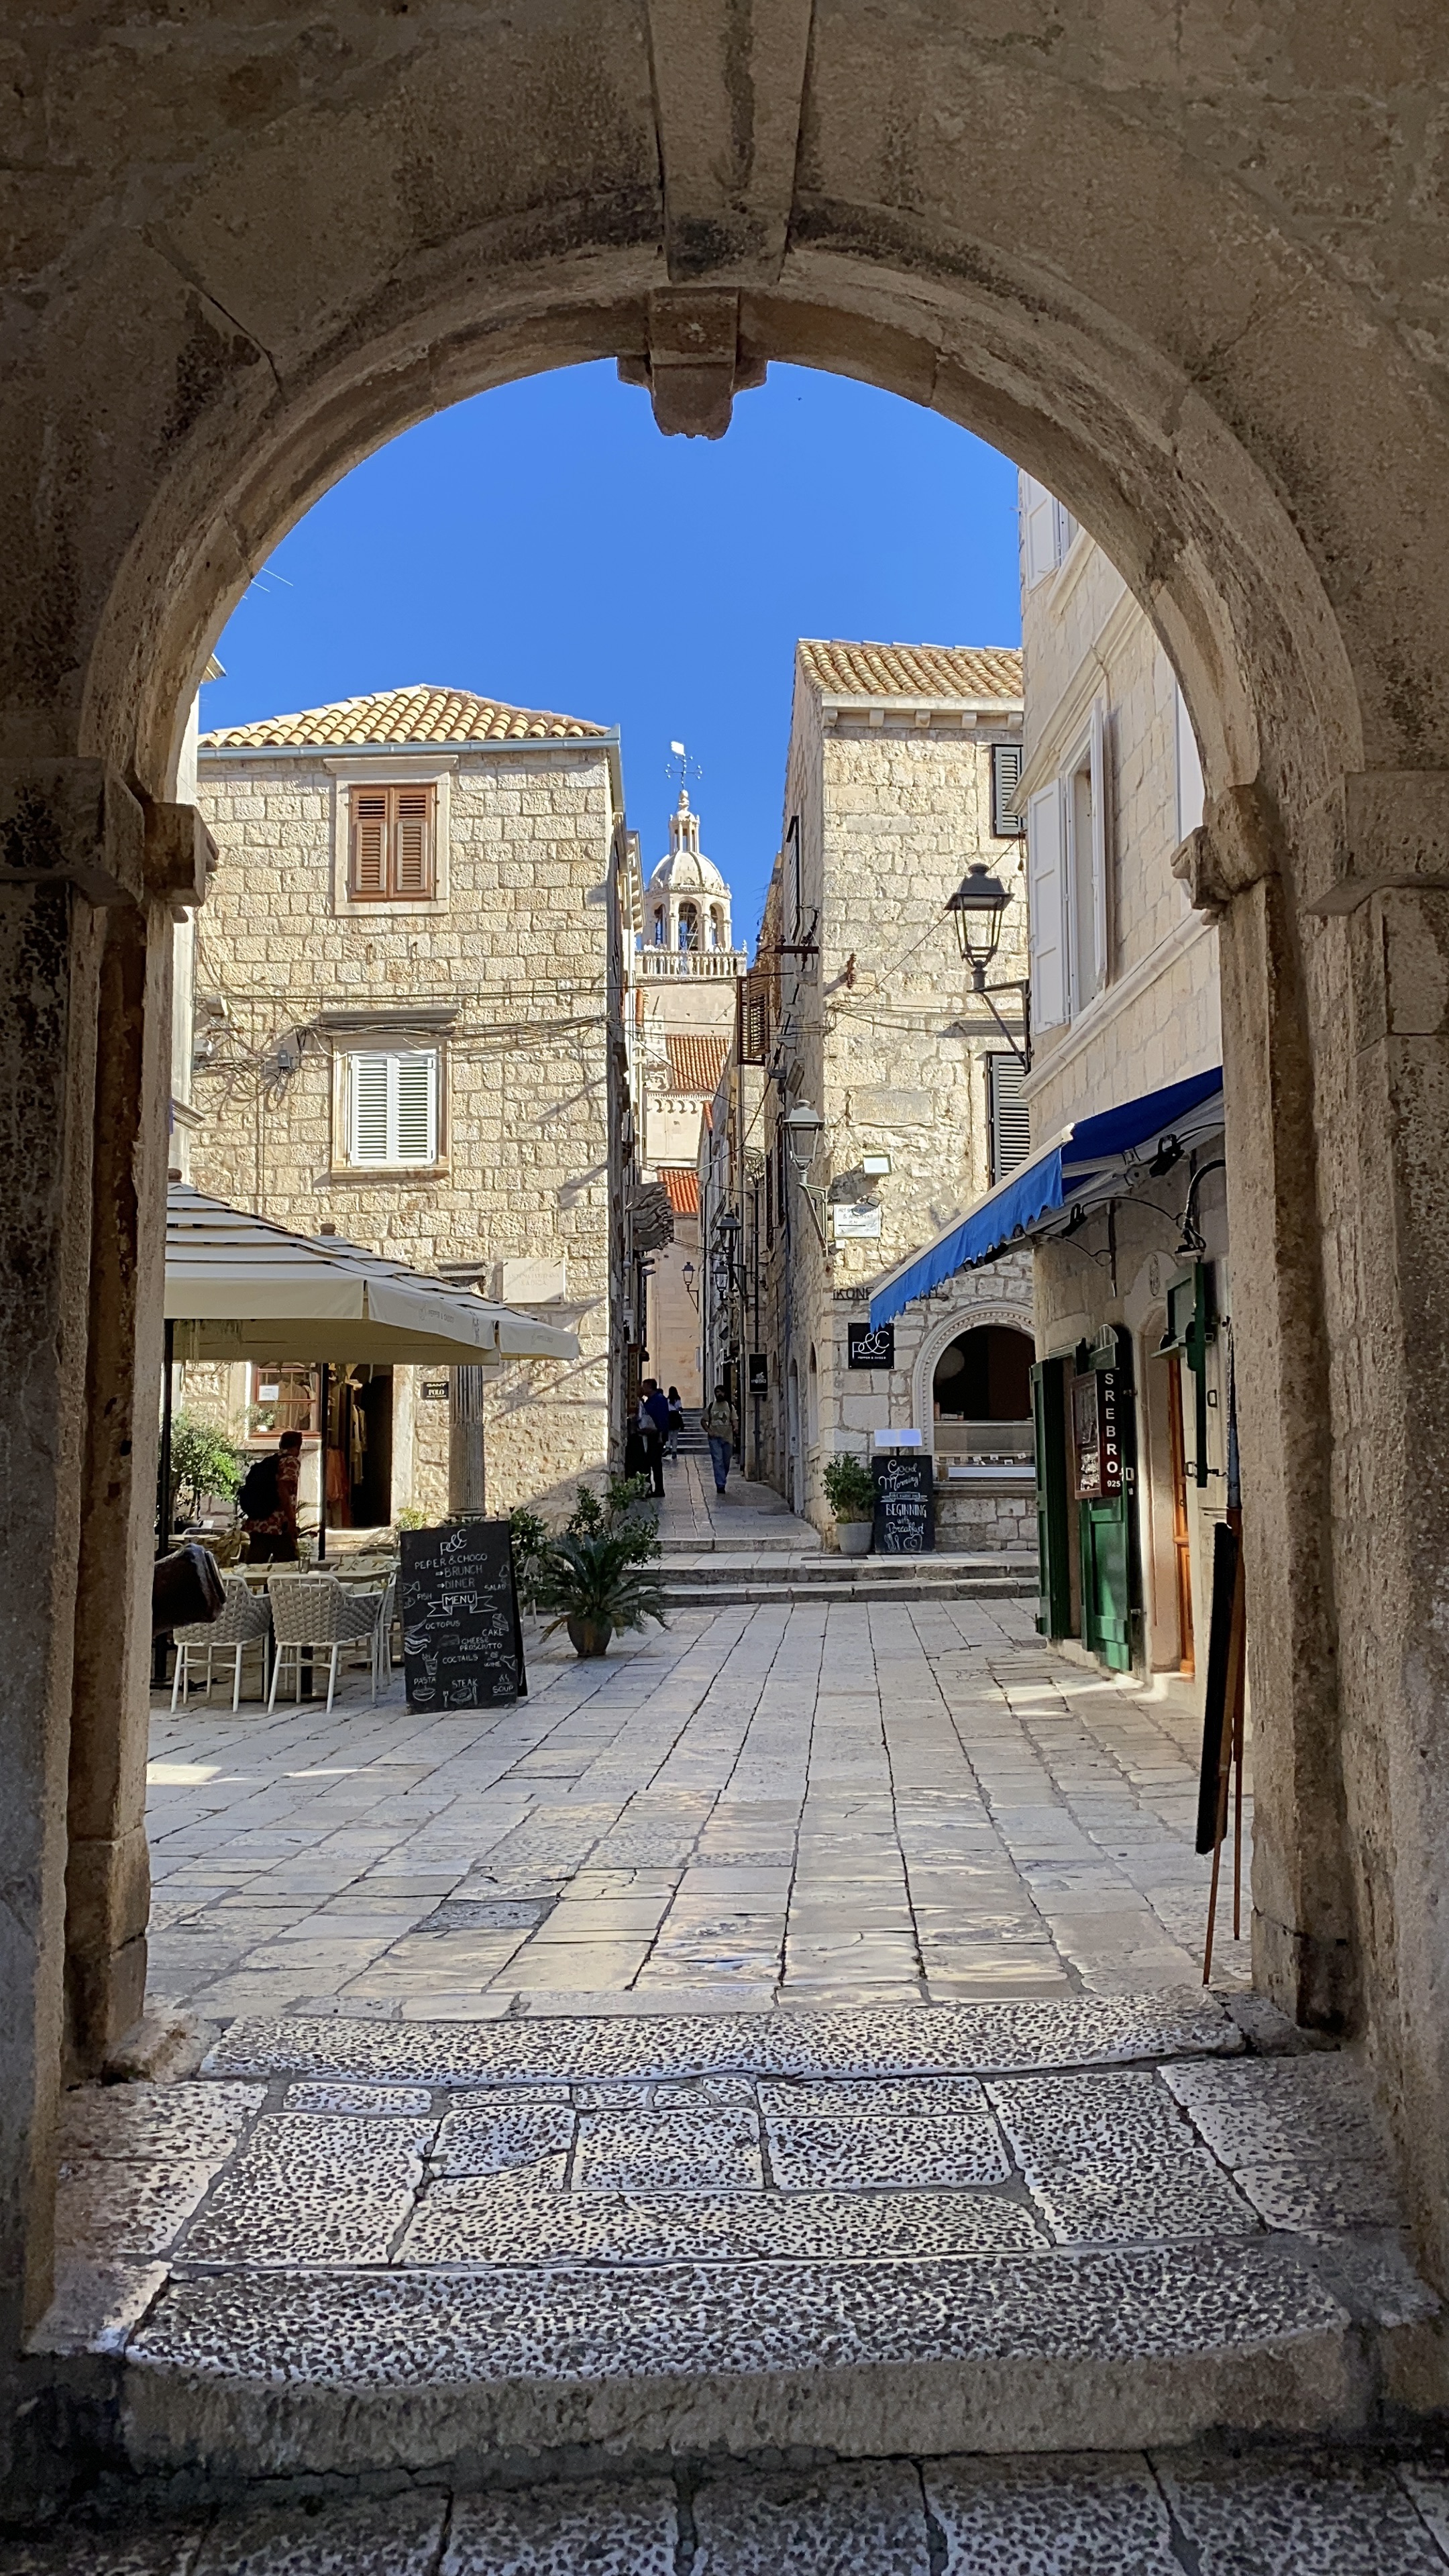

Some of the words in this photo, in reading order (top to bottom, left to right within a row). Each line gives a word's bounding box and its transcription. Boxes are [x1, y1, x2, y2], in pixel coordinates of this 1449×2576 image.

[1105, 1373, 1119, 1474] SREBRO
[1107, 1480, 1121, 1488] 925
[885, 1503, 927, 1518] BEGINNING
[415, 1558, 447, 1570] PEPER
[457, 1553, 488, 1563] CHOCO
[444, 1565, 483, 1578] BRUNCH
[445, 1578, 476, 1590] DINER
[445, 1594, 476, 1605] MENU
[425, 1620, 461, 1630] OCTOPUS
[482, 1629, 504, 1637] CAKE
[461, 1637, 489, 1645] CHEESE
[442, 1654, 478, 1664] COCTAILS
[413, 1677, 437, 1685] PASTA
[451, 1678, 478, 1688] STEAK
[492, 1685, 514, 1694] SOUP
